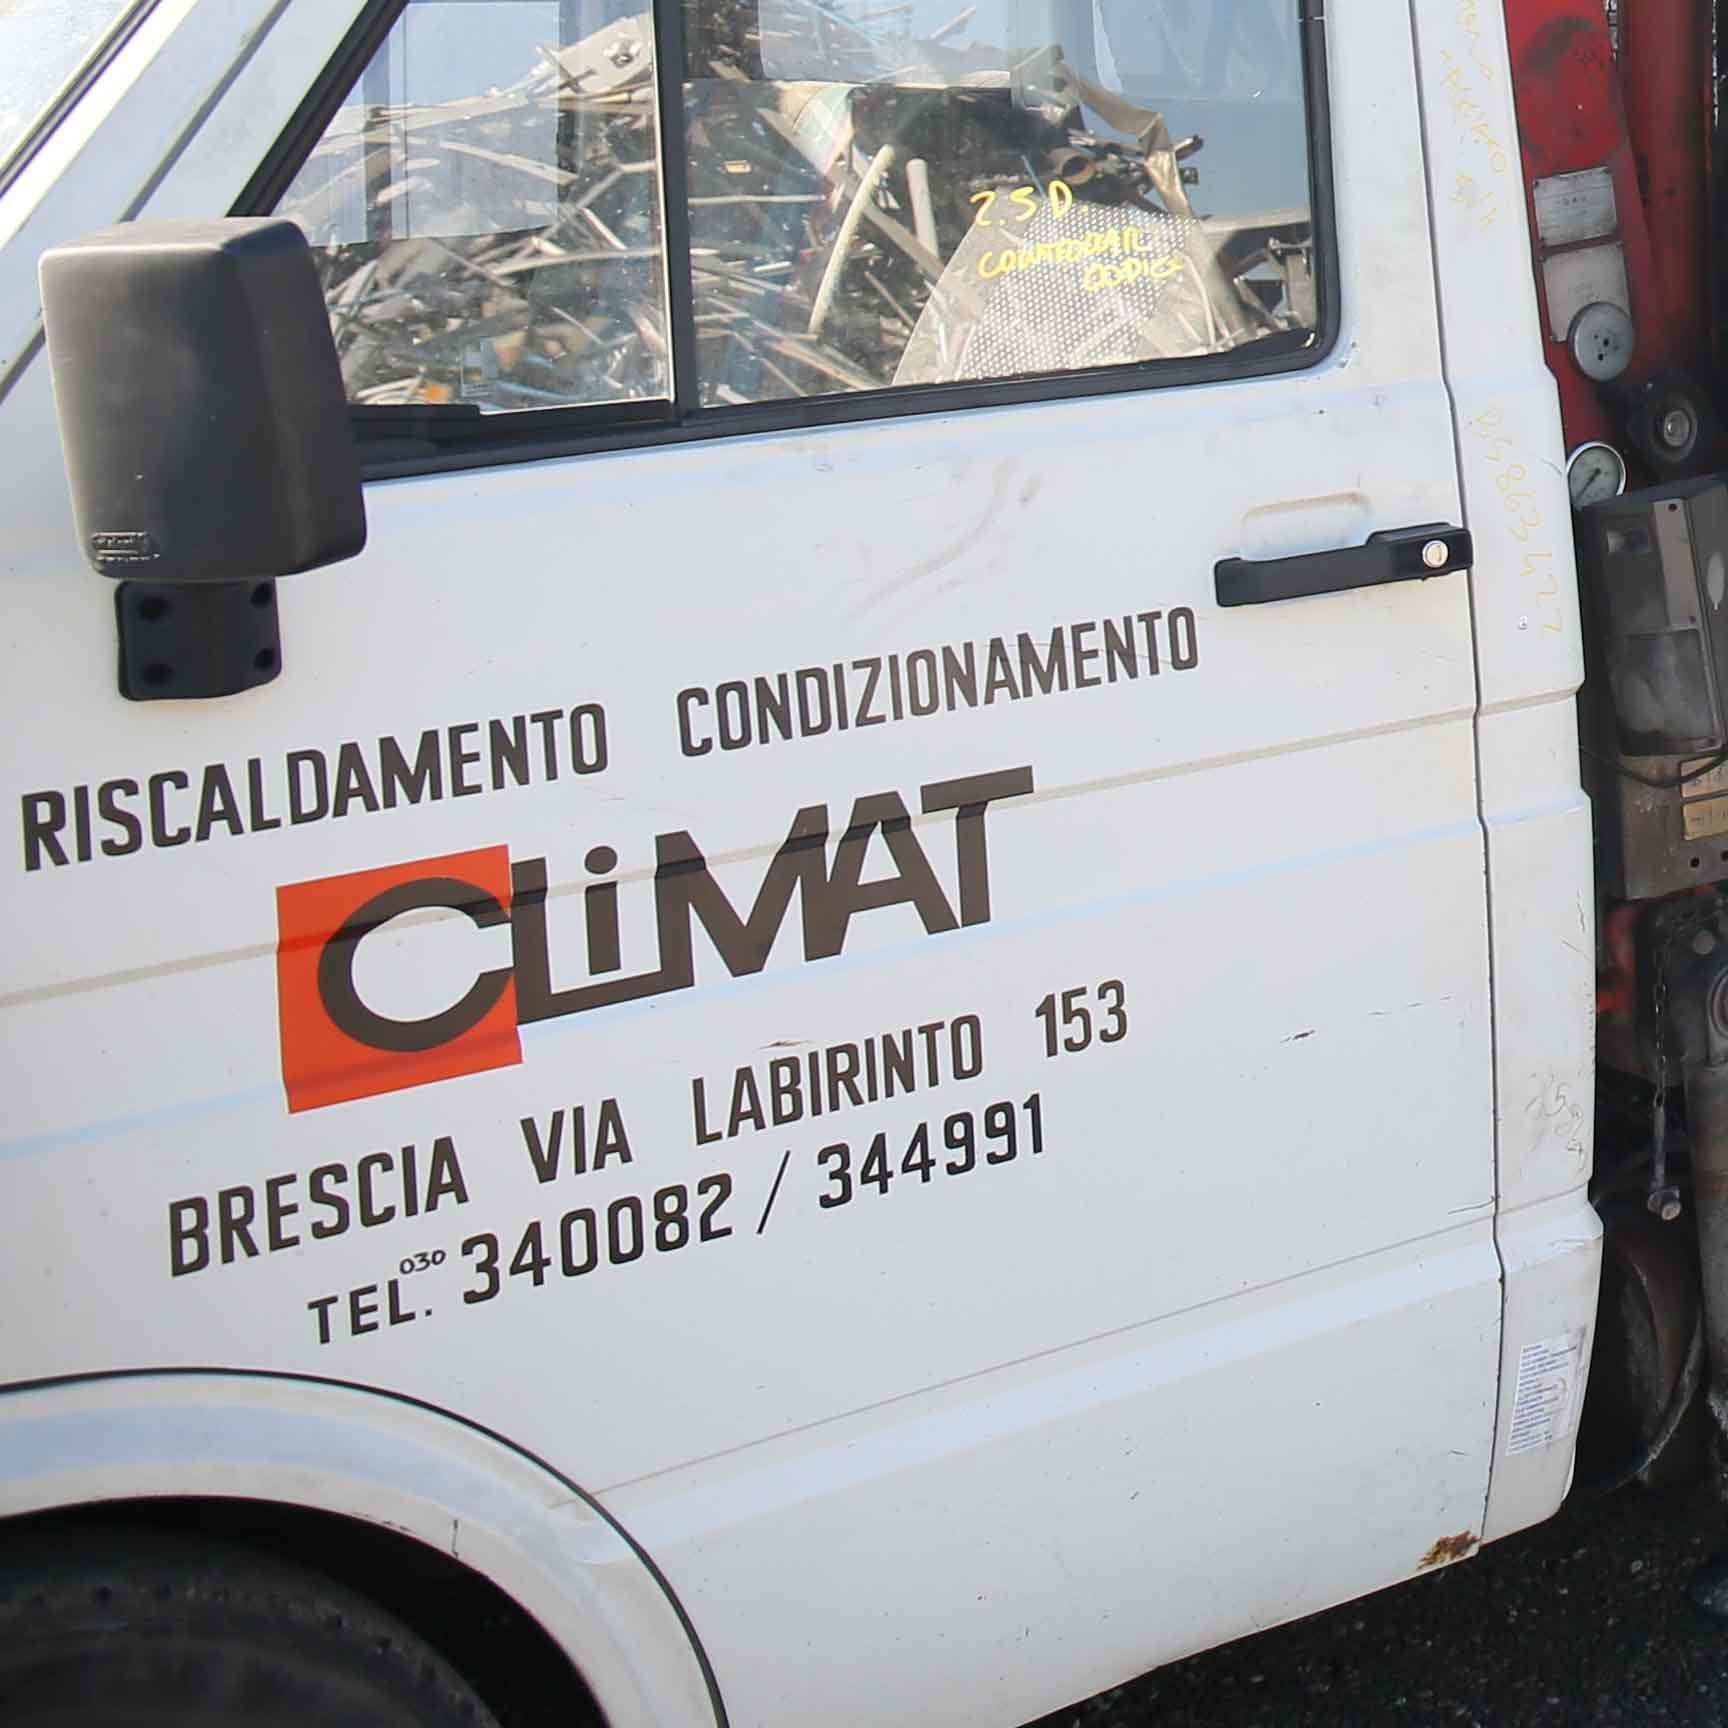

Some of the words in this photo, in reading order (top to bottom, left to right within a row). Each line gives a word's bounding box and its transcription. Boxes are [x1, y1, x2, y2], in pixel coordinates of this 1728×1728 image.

[21, 702, 610, 872] RISCALDAMENTO
[676, 606, 1201, 758] CONDIZIONAMENTO
[169, 1136, 470, 1278] BRESCIA
[520, 1098, 634, 1184] VIA
[692, 1013, 985, 1147] LABIRINTO
[1034, 979, 1130, 1059] 153
[307, 1276, 434, 1345] TEL.
[461, 1173, 734, 1305] 340082
[756, 1149, 791, 1235] /
[816, 1093, 1044, 1210] 344991
[399, 1249, 446, 1275] 030
